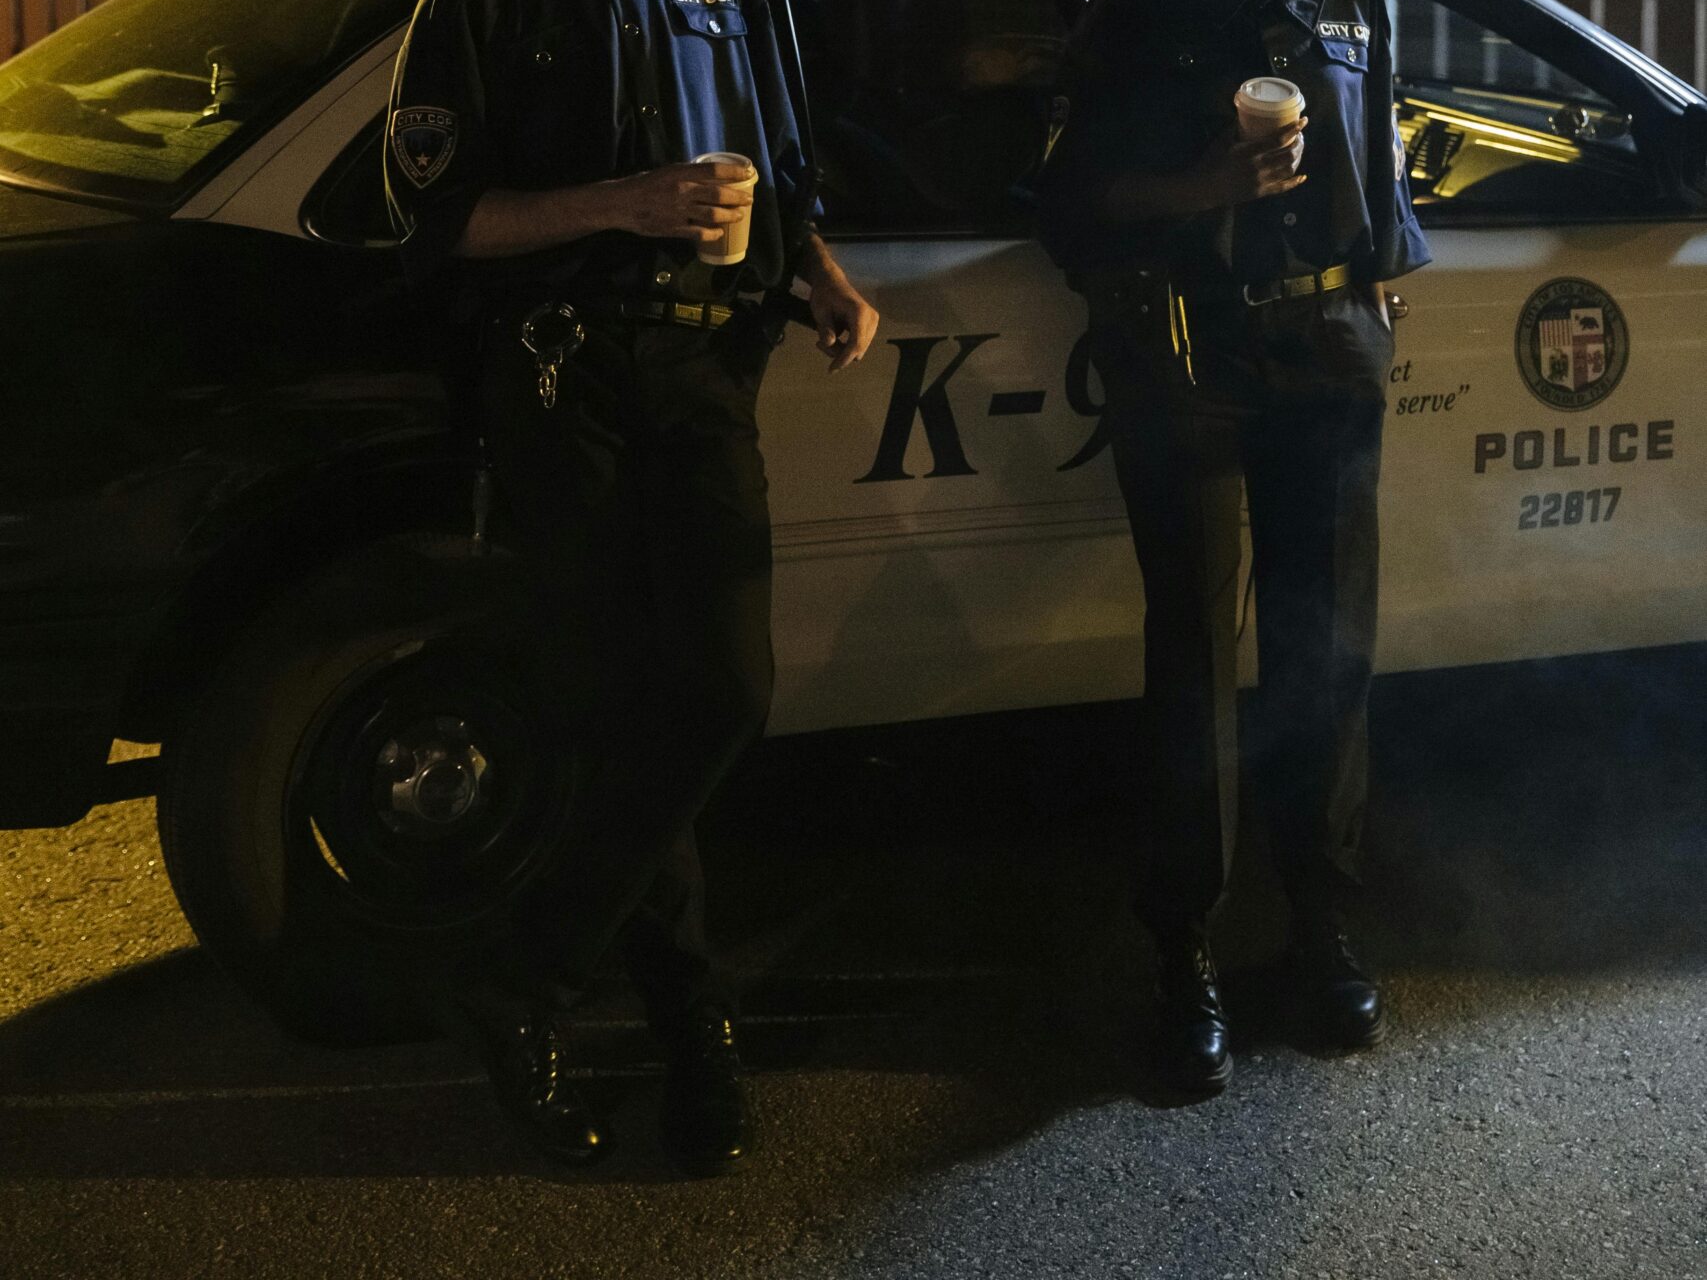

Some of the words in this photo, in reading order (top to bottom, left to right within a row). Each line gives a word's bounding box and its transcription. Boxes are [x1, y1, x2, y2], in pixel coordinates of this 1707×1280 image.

[1320, 23, 1349, 37] CITY
[1354, 25, 1370, 41] CO
[397, 113, 422, 126] CITY
[1475, 420, 1674, 474] POLICE
[1518, 487, 1622, 531] 22817
